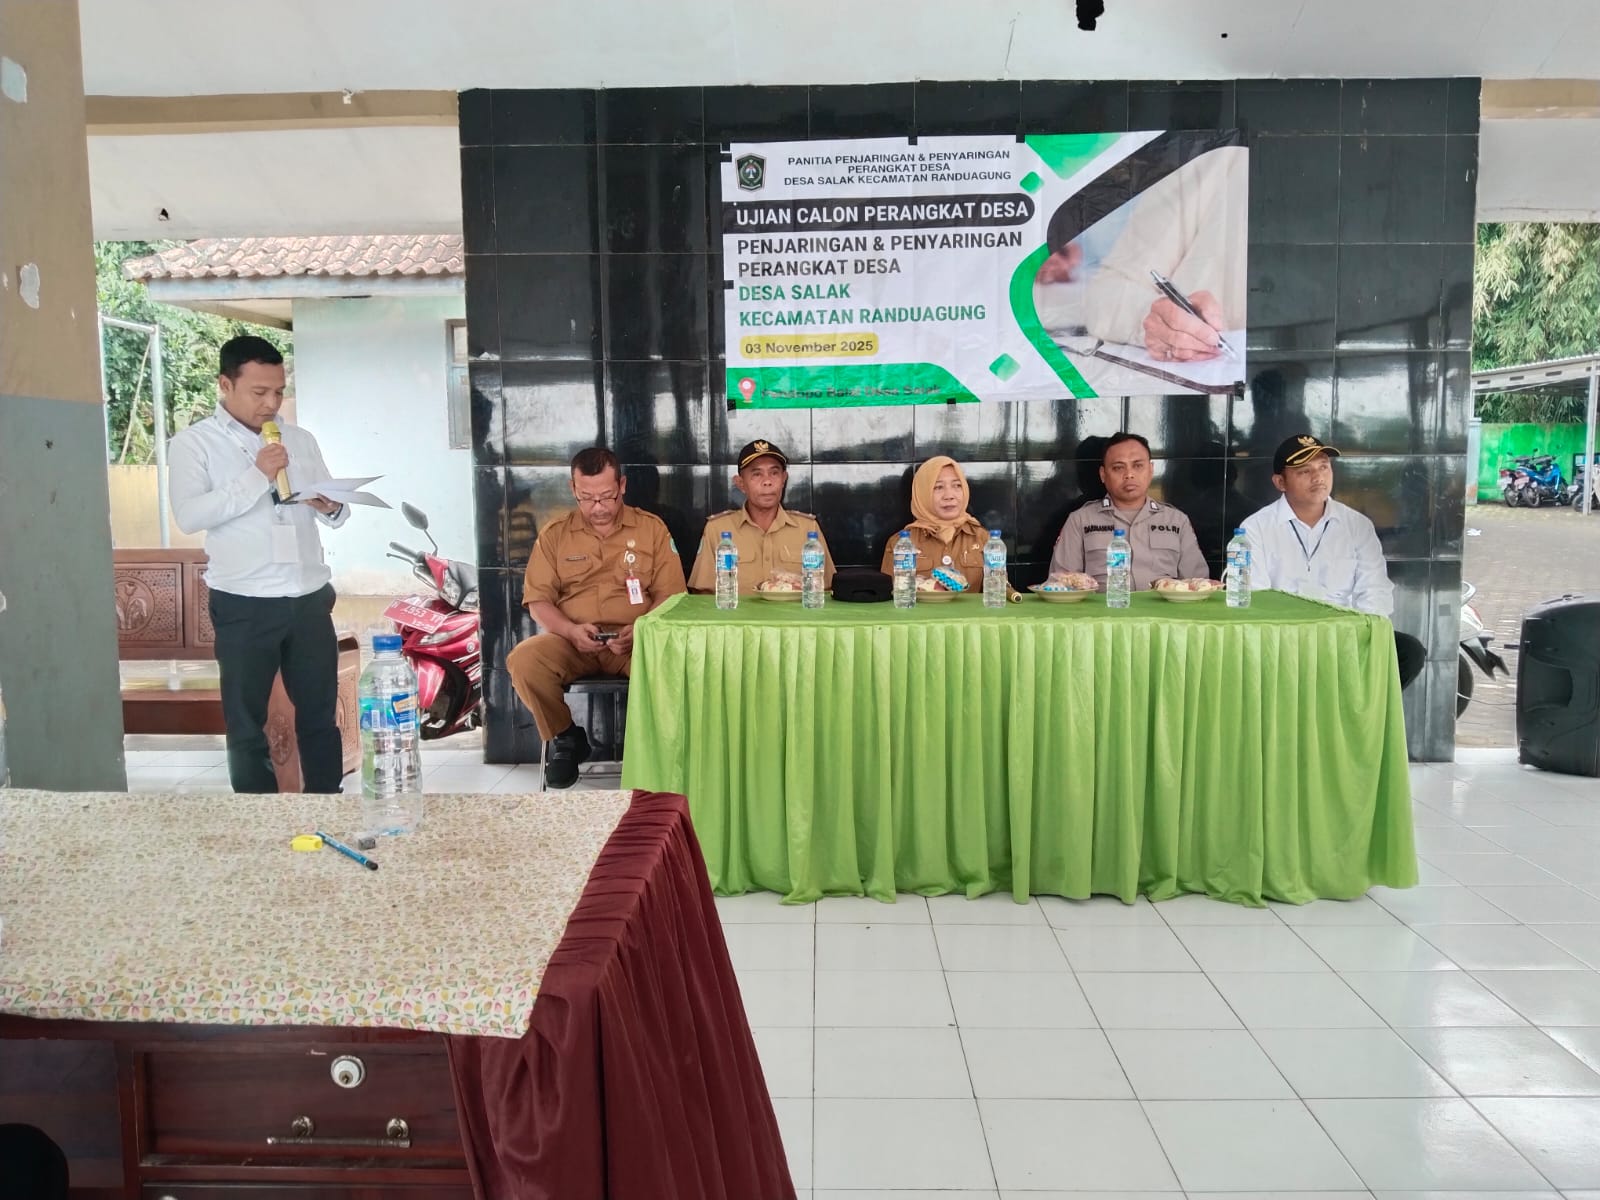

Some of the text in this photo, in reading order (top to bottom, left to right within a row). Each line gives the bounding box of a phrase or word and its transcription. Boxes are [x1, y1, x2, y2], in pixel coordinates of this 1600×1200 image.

[788, 150, 1010, 166] PANITIA PENJARINGAN & PENYARINGAN
[848, 162, 951, 174] PERANGKAT DESA
[784, 171, 1012, 186] DESA SALAK KECAMATAN RANDUAGUNG
[736, 201, 1029, 226] UJIAN CALON PERANGKAT DESA
[737, 231, 1022, 255] PENJARINGAN & PENYARINGAN
[738, 258, 901, 277] PERANGKAT DESA
[738, 283, 851, 301] DESA SALAK
[739, 304, 986, 327] KECAMATAN RANDUAGUNG
[745, 340, 873, 354] 03 November 2025
[1150, 524, 1180, 534] POLRI
